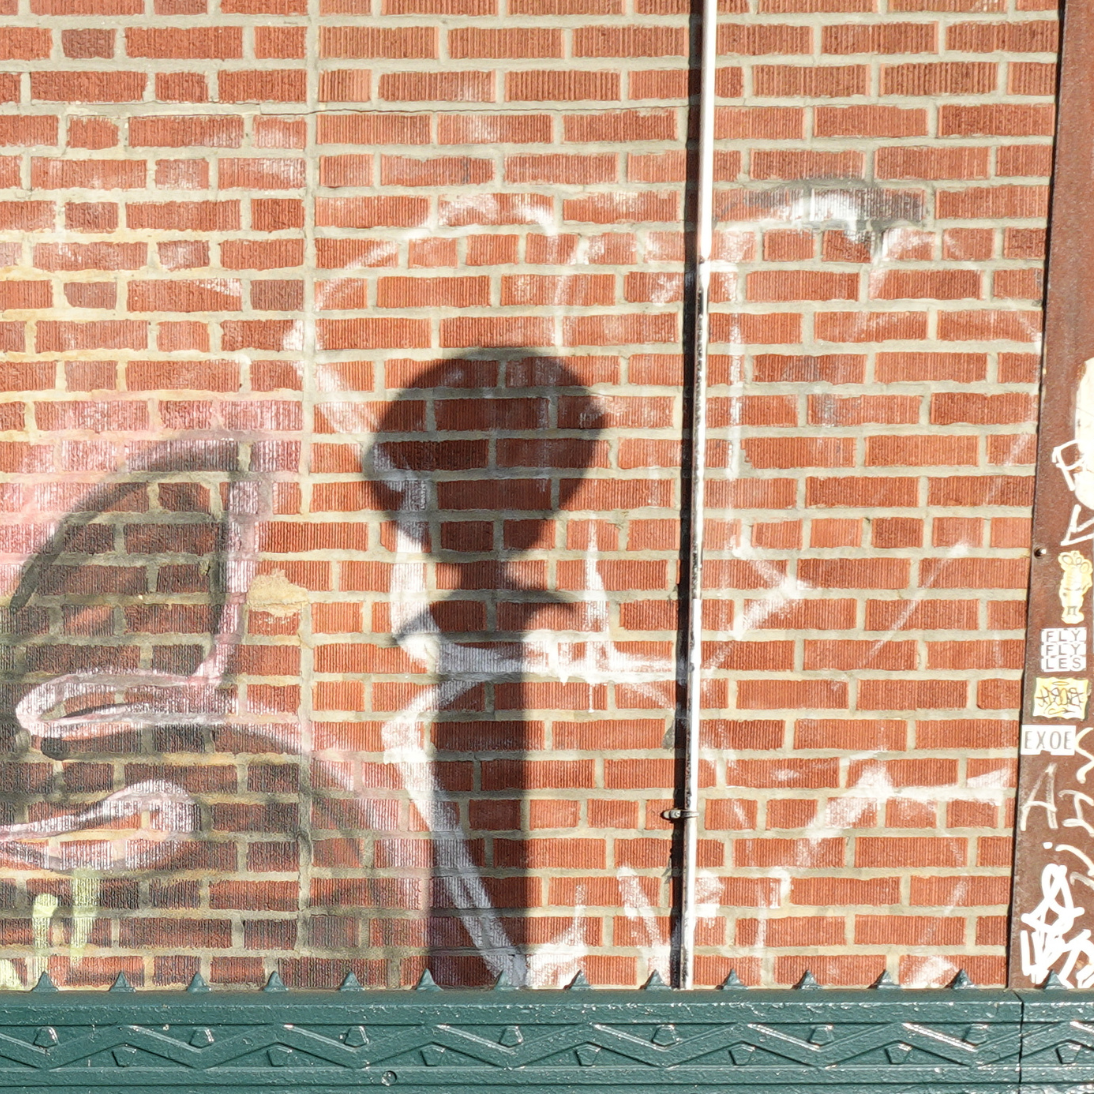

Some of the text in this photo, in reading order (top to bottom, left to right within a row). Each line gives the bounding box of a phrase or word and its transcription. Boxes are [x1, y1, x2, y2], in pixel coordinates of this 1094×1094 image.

[1045, 630, 1081, 642] FLY
[1045, 644, 1081, 656] FLY
[1045, 657, 1082, 669] LES
